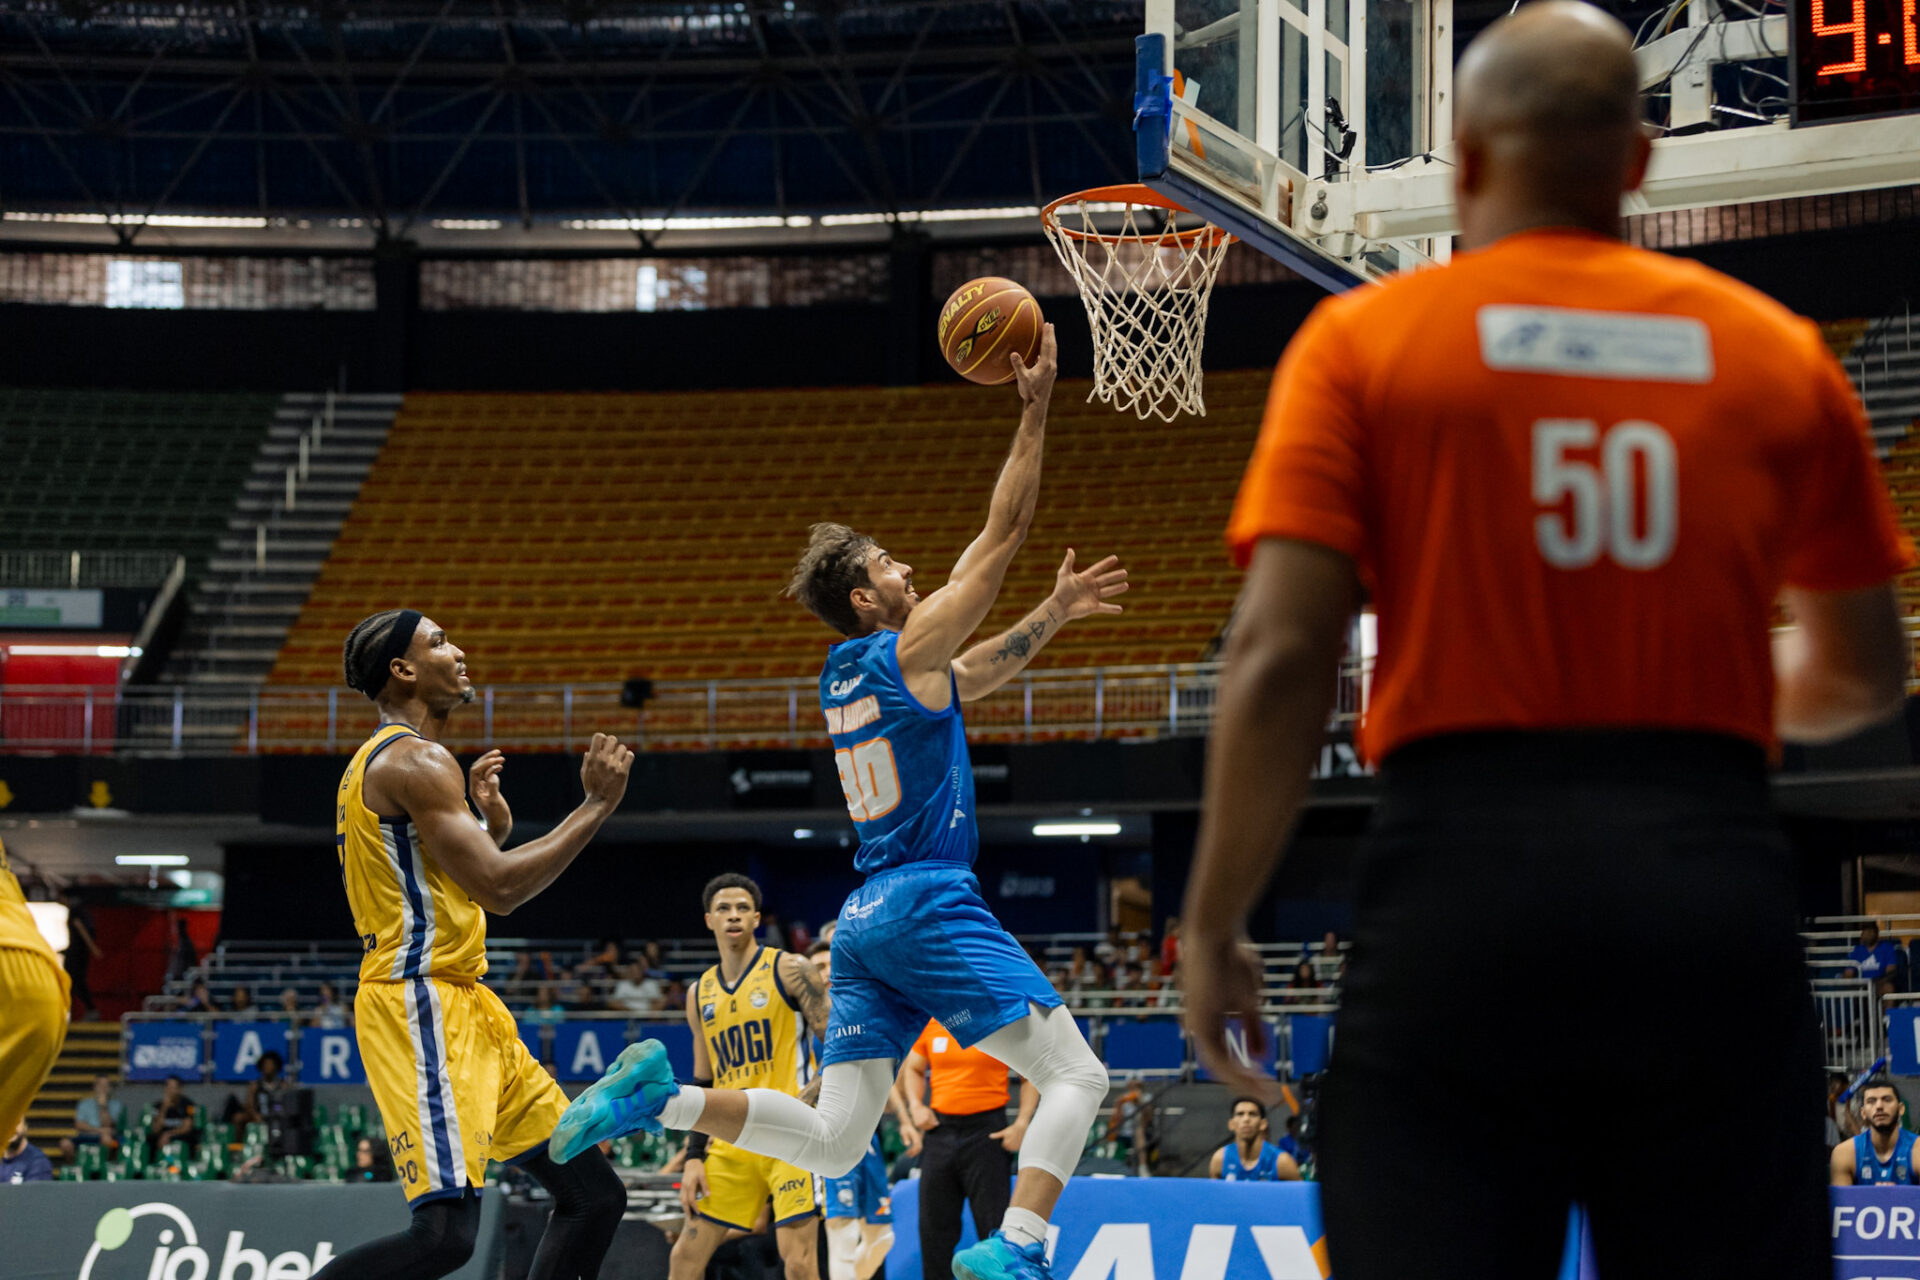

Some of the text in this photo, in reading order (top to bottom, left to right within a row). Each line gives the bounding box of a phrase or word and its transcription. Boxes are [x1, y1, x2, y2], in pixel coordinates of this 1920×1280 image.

[1531, 416, 1679, 571] 50
[320, 1036, 351, 1079] R
[571, 1030, 604, 1074] A
[711, 1019, 773, 1079] MOGI
[1832, 1206, 1920, 1240] FOR
